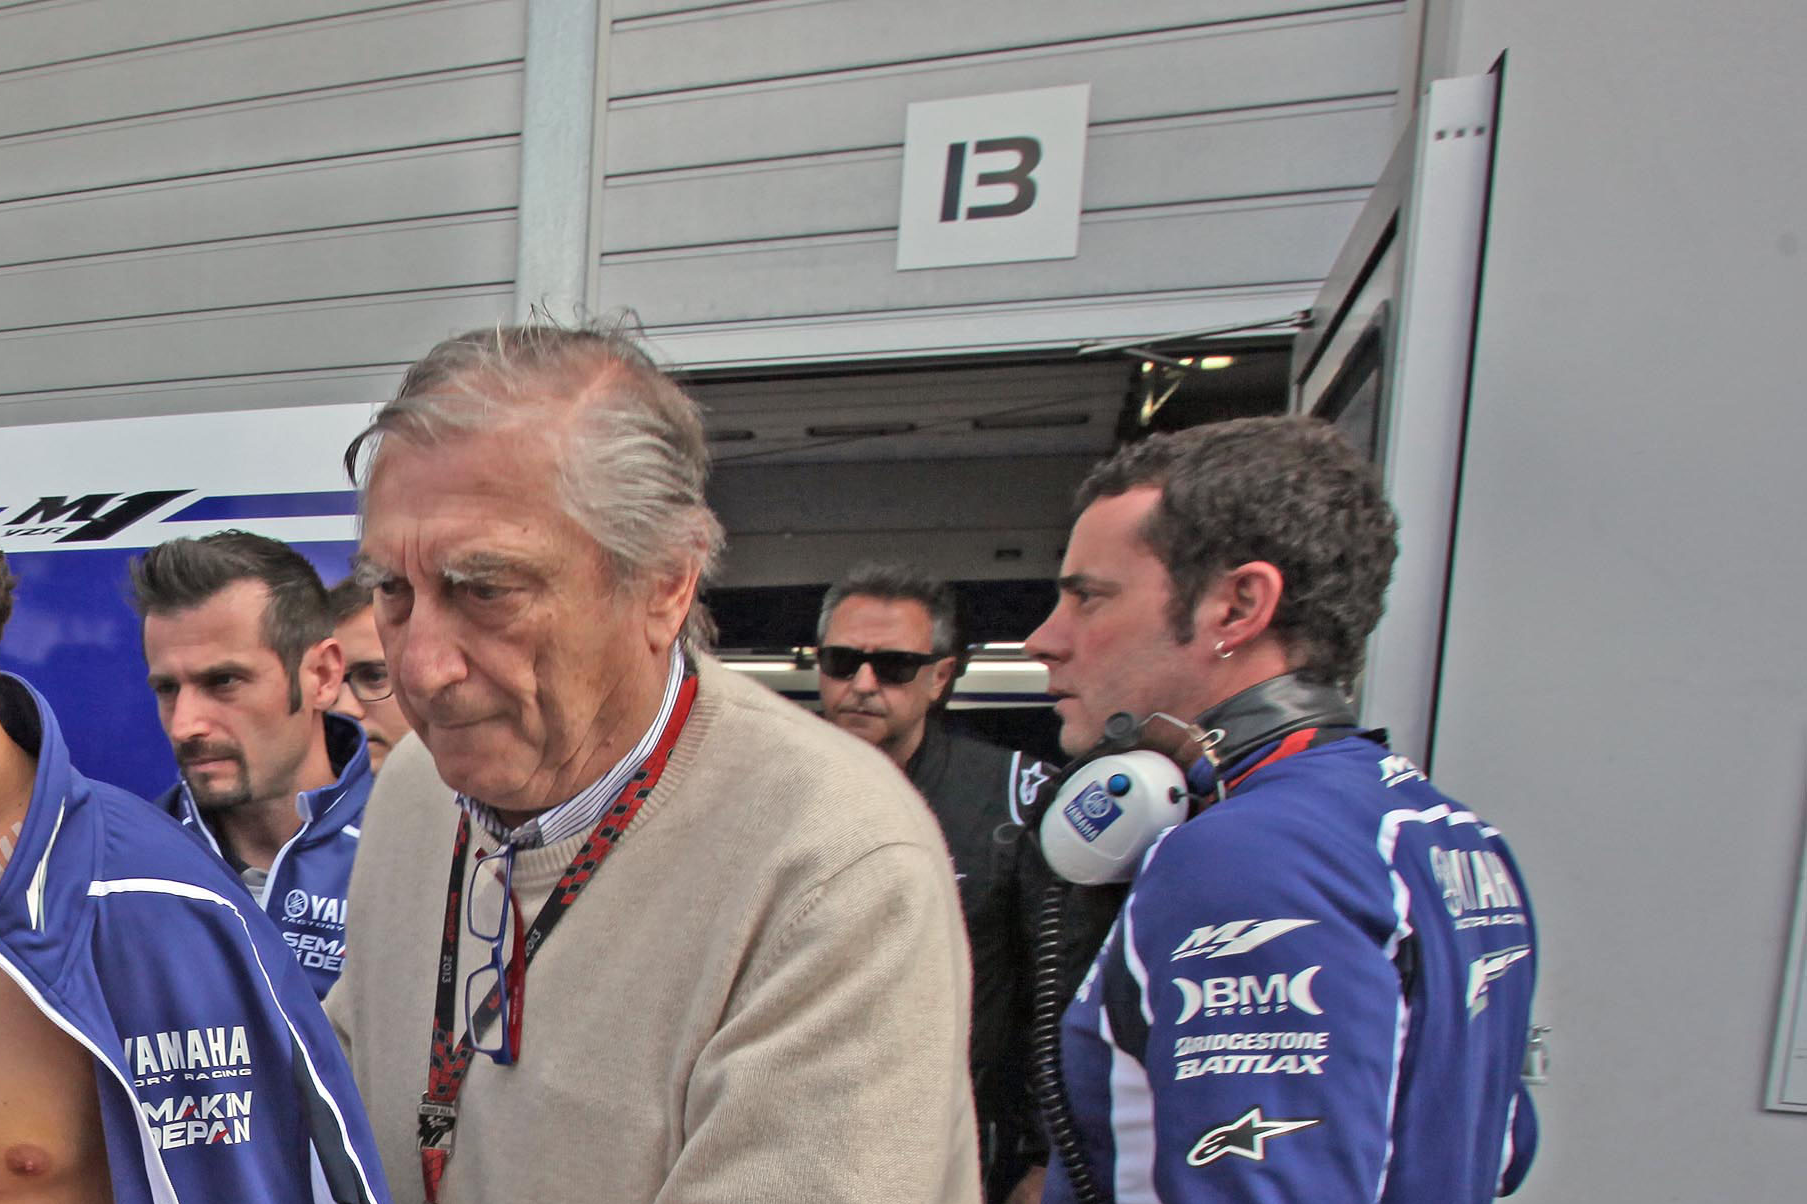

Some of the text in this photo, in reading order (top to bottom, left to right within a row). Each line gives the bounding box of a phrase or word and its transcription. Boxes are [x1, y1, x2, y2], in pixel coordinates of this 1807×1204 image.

[939, 136, 1043, 223] 13
[442, 955, 453, 984] 2013
[1173, 1031, 1330, 1058] BRIDGESTONE
[184, 1068, 253, 1081] RACING
[1174, 1054, 1330, 1081] BATTLAX
